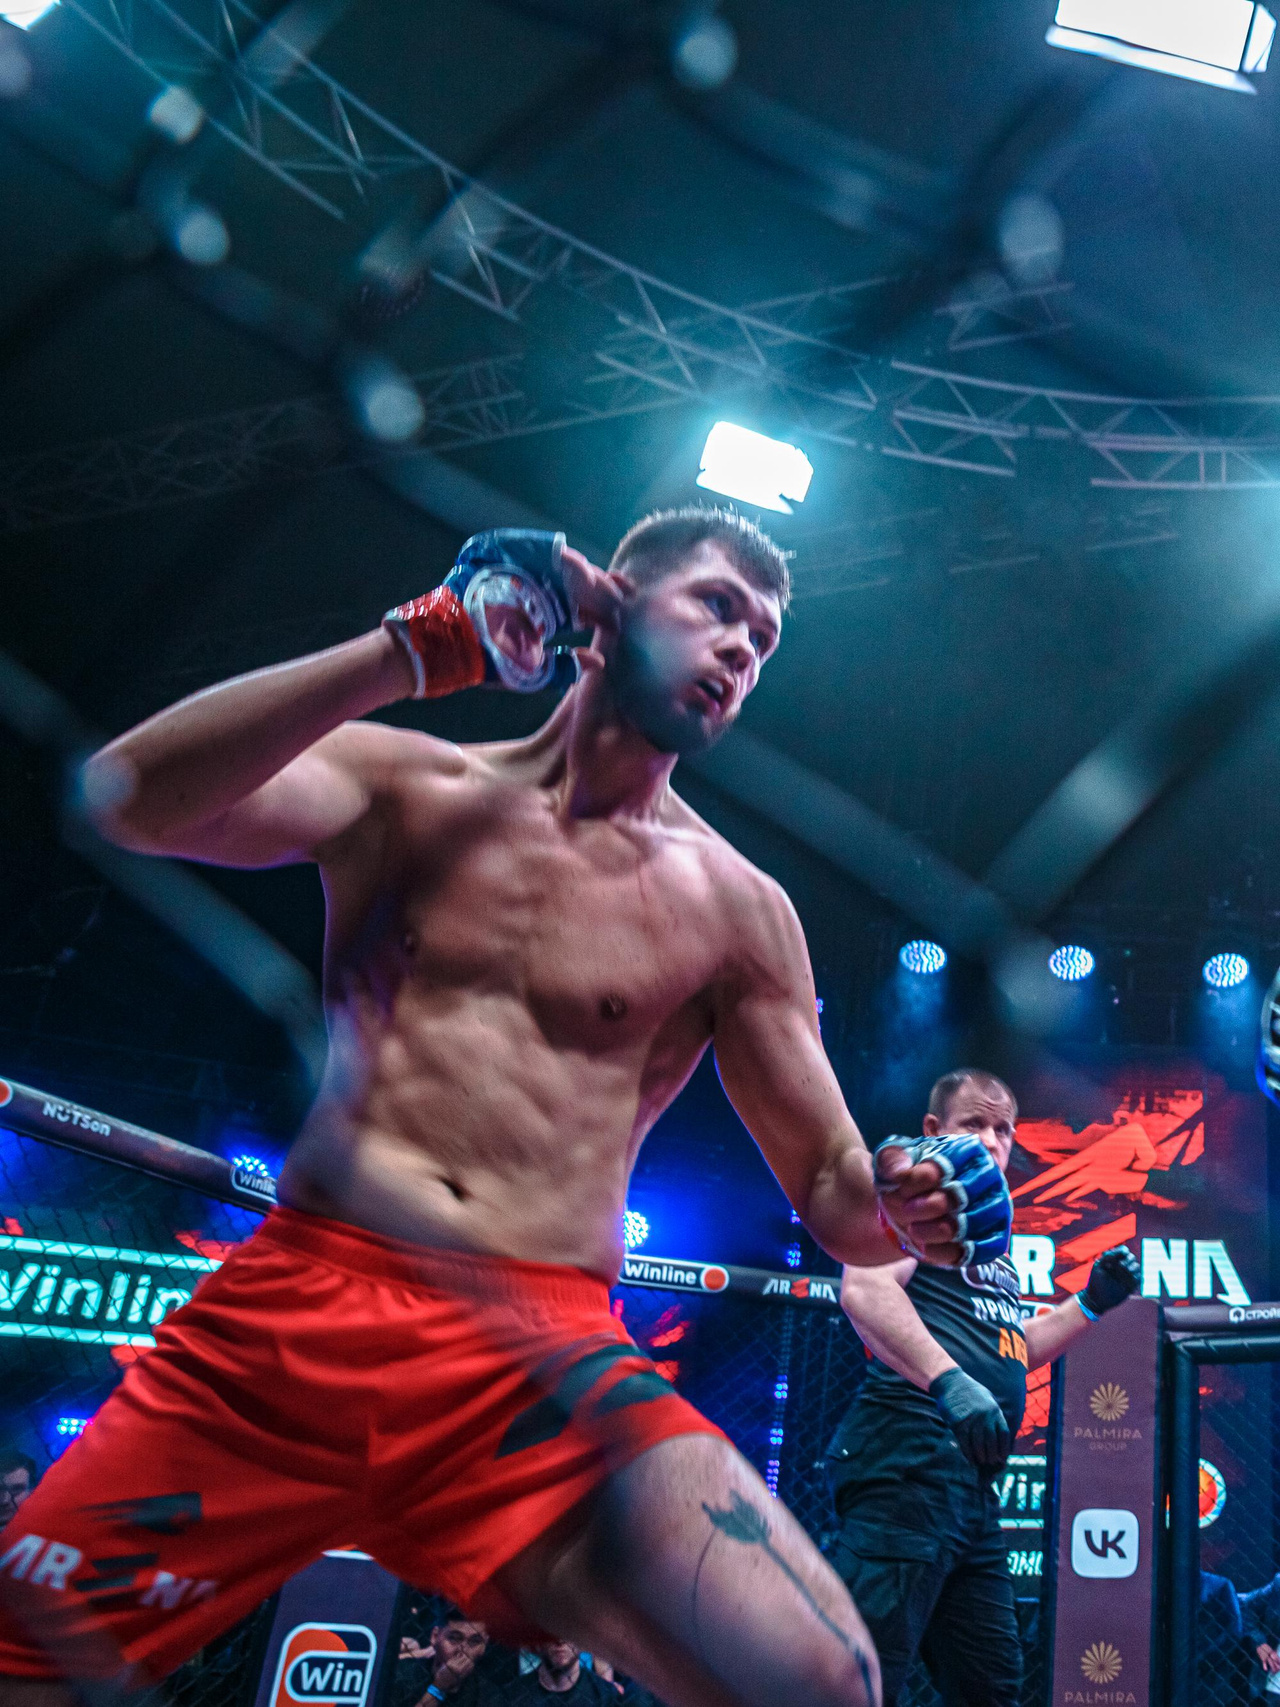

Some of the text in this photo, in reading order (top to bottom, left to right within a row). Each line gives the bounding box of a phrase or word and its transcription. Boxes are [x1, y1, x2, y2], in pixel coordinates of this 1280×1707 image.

[624, 1261, 697, 1285] Winline
[762, 1277, 838, 1304] ARENA
[1073, 1426, 1143, 1440] PALMIRA
[1084, 1529, 1127, 1559] VK
[300, 1661, 364, 1693] Win
[1064, 1691, 1137, 1704] PALMIRA
